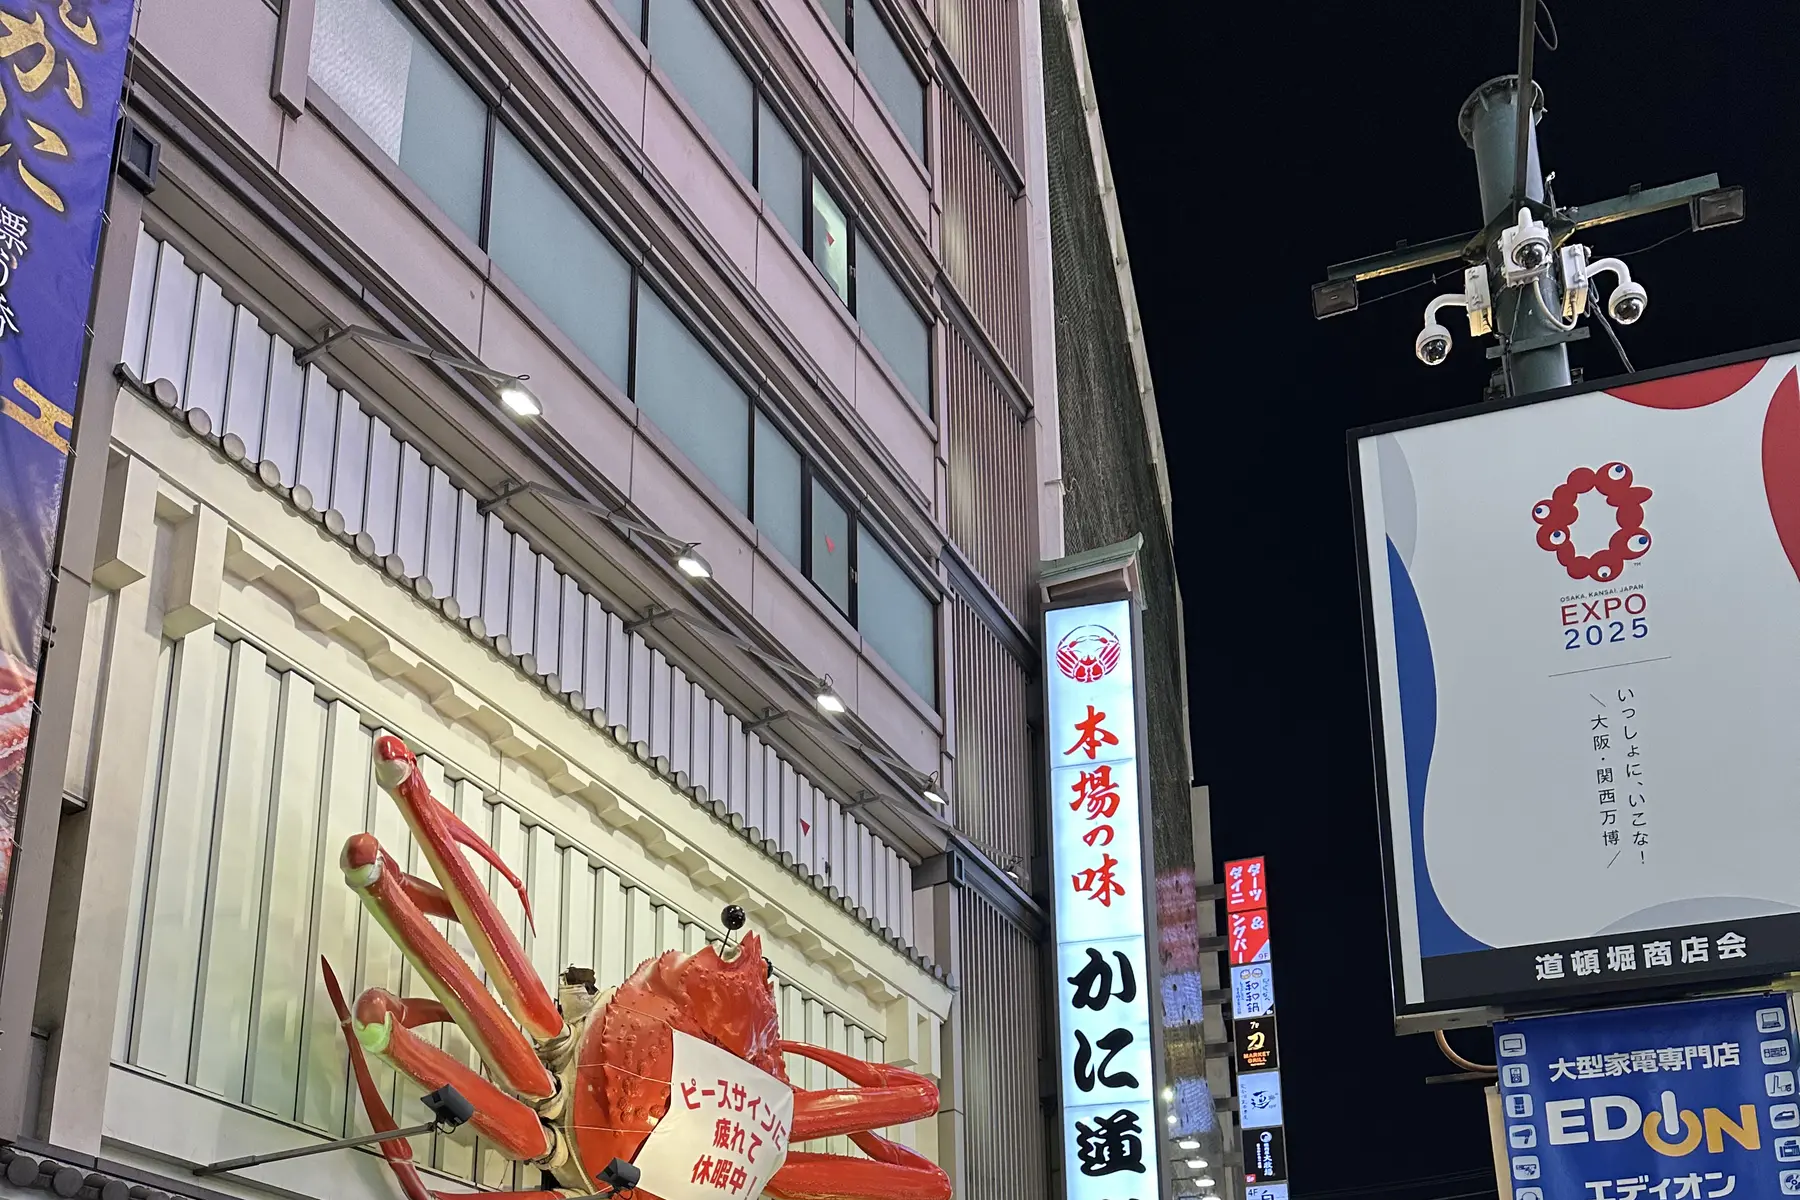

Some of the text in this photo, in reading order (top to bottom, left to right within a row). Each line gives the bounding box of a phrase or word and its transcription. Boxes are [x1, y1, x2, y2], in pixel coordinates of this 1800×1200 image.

[1560, 594, 1587, 602] OSAKA,
[1620, 584, 1644, 592] JAPAN
[1561, 594, 1646, 626] EXPO
[1564, 617, 1649, 650] 2025
[1590, 713, 1620, 847] 大阪・関西万博
[1063, 705, 1126, 907] 本場の味
[1247, 863, 1262, 901] ダーツ
[1229, 866, 1248, 964] ダイニングバー
[1533, 931, 1748, 982] 道頓堀商店会
[1548, 1042, 1741, 1083] 大型家電専門店
[680, 1077, 787, 1151] ピースサインに
[1545, 1090, 1761, 1157] EDION
[712, 1117, 763, 1164] 疲れて
[1248, 1188, 1258, 1197] 4F
